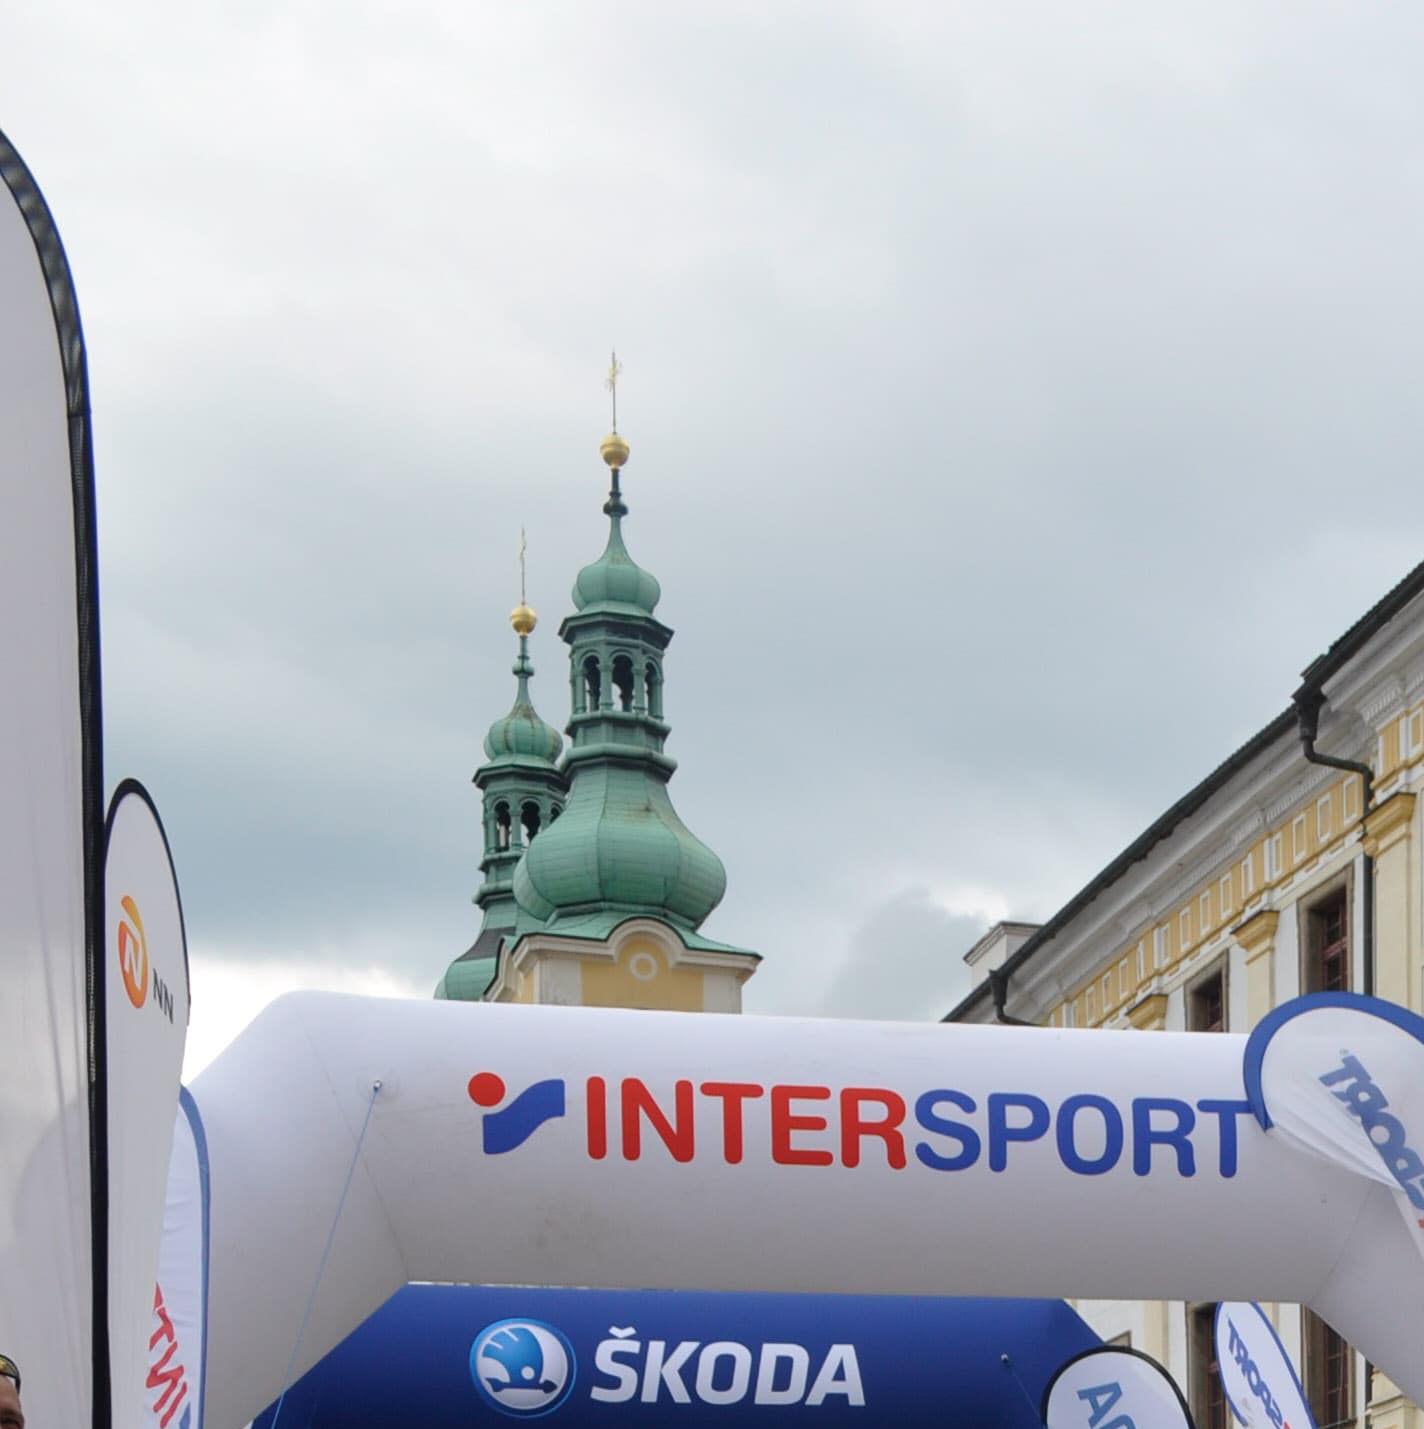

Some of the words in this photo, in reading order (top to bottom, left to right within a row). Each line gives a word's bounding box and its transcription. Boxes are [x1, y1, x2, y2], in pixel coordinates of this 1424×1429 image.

[153, 968, 174, 1024] NN
[586, 1075, 1254, 1178] INTERSPORT
[591, 1326, 866, 1406] ŠKODA
